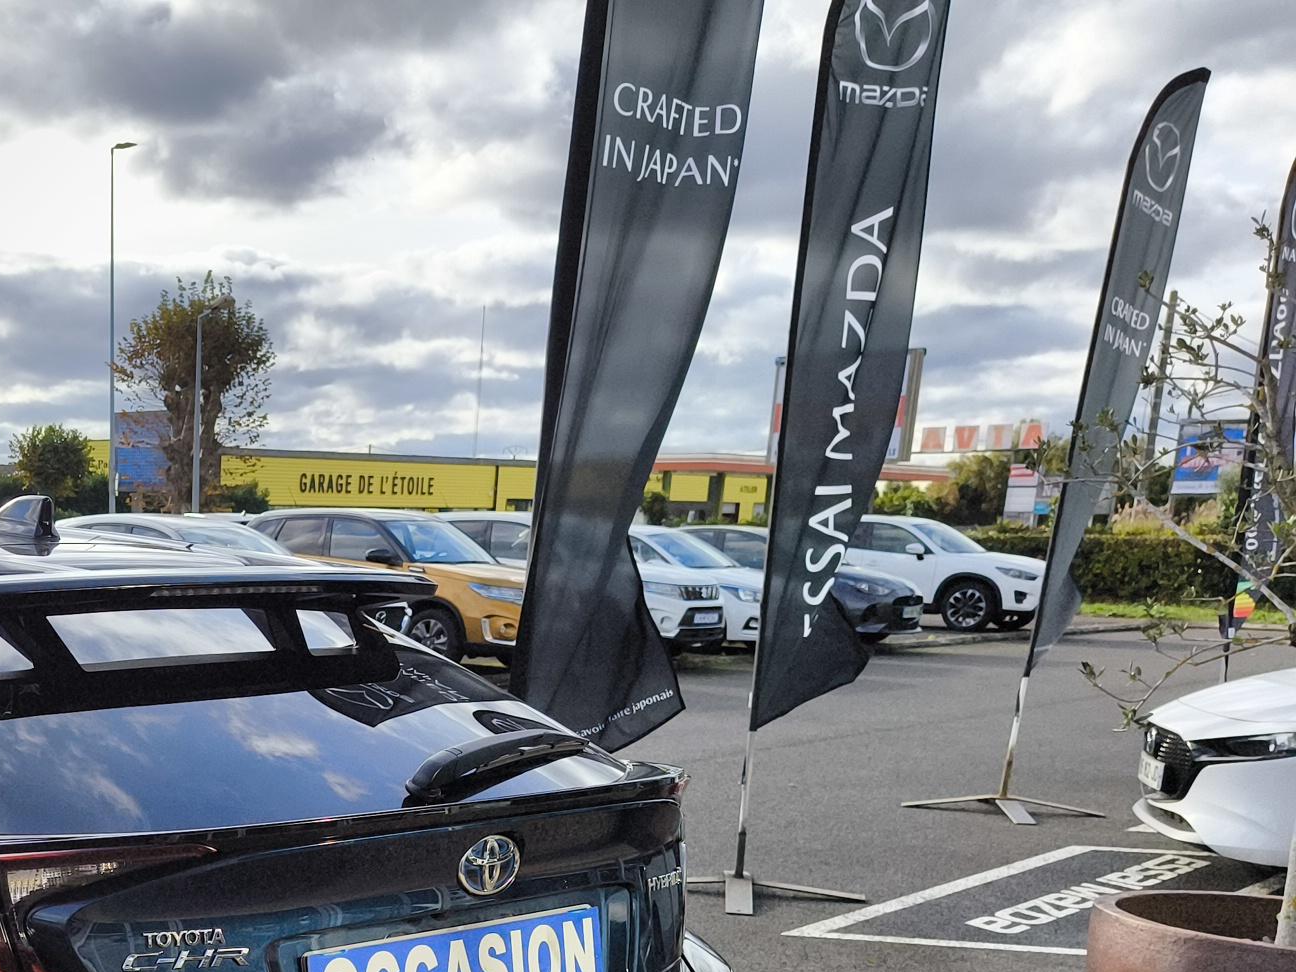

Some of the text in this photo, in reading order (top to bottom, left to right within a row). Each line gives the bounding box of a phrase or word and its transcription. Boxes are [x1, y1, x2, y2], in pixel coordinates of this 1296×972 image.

[613, 82, 742, 137] CRAFTED
[602, 134, 636, 173] IN
[1133, 189, 1173, 227] mazda
[1111, 296, 1150, 330] CRAED
[825, 206, 894, 460] MAZDA
[921, 424, 1044, 452] AVIA
[299, 471, 435, 496] GARAGE DE L'ÉTOILE
[631, 688, 674, 714] japonais
[142, 928, 226, 949] TOYOTA
[121, 947, 251, 972] C-HR
